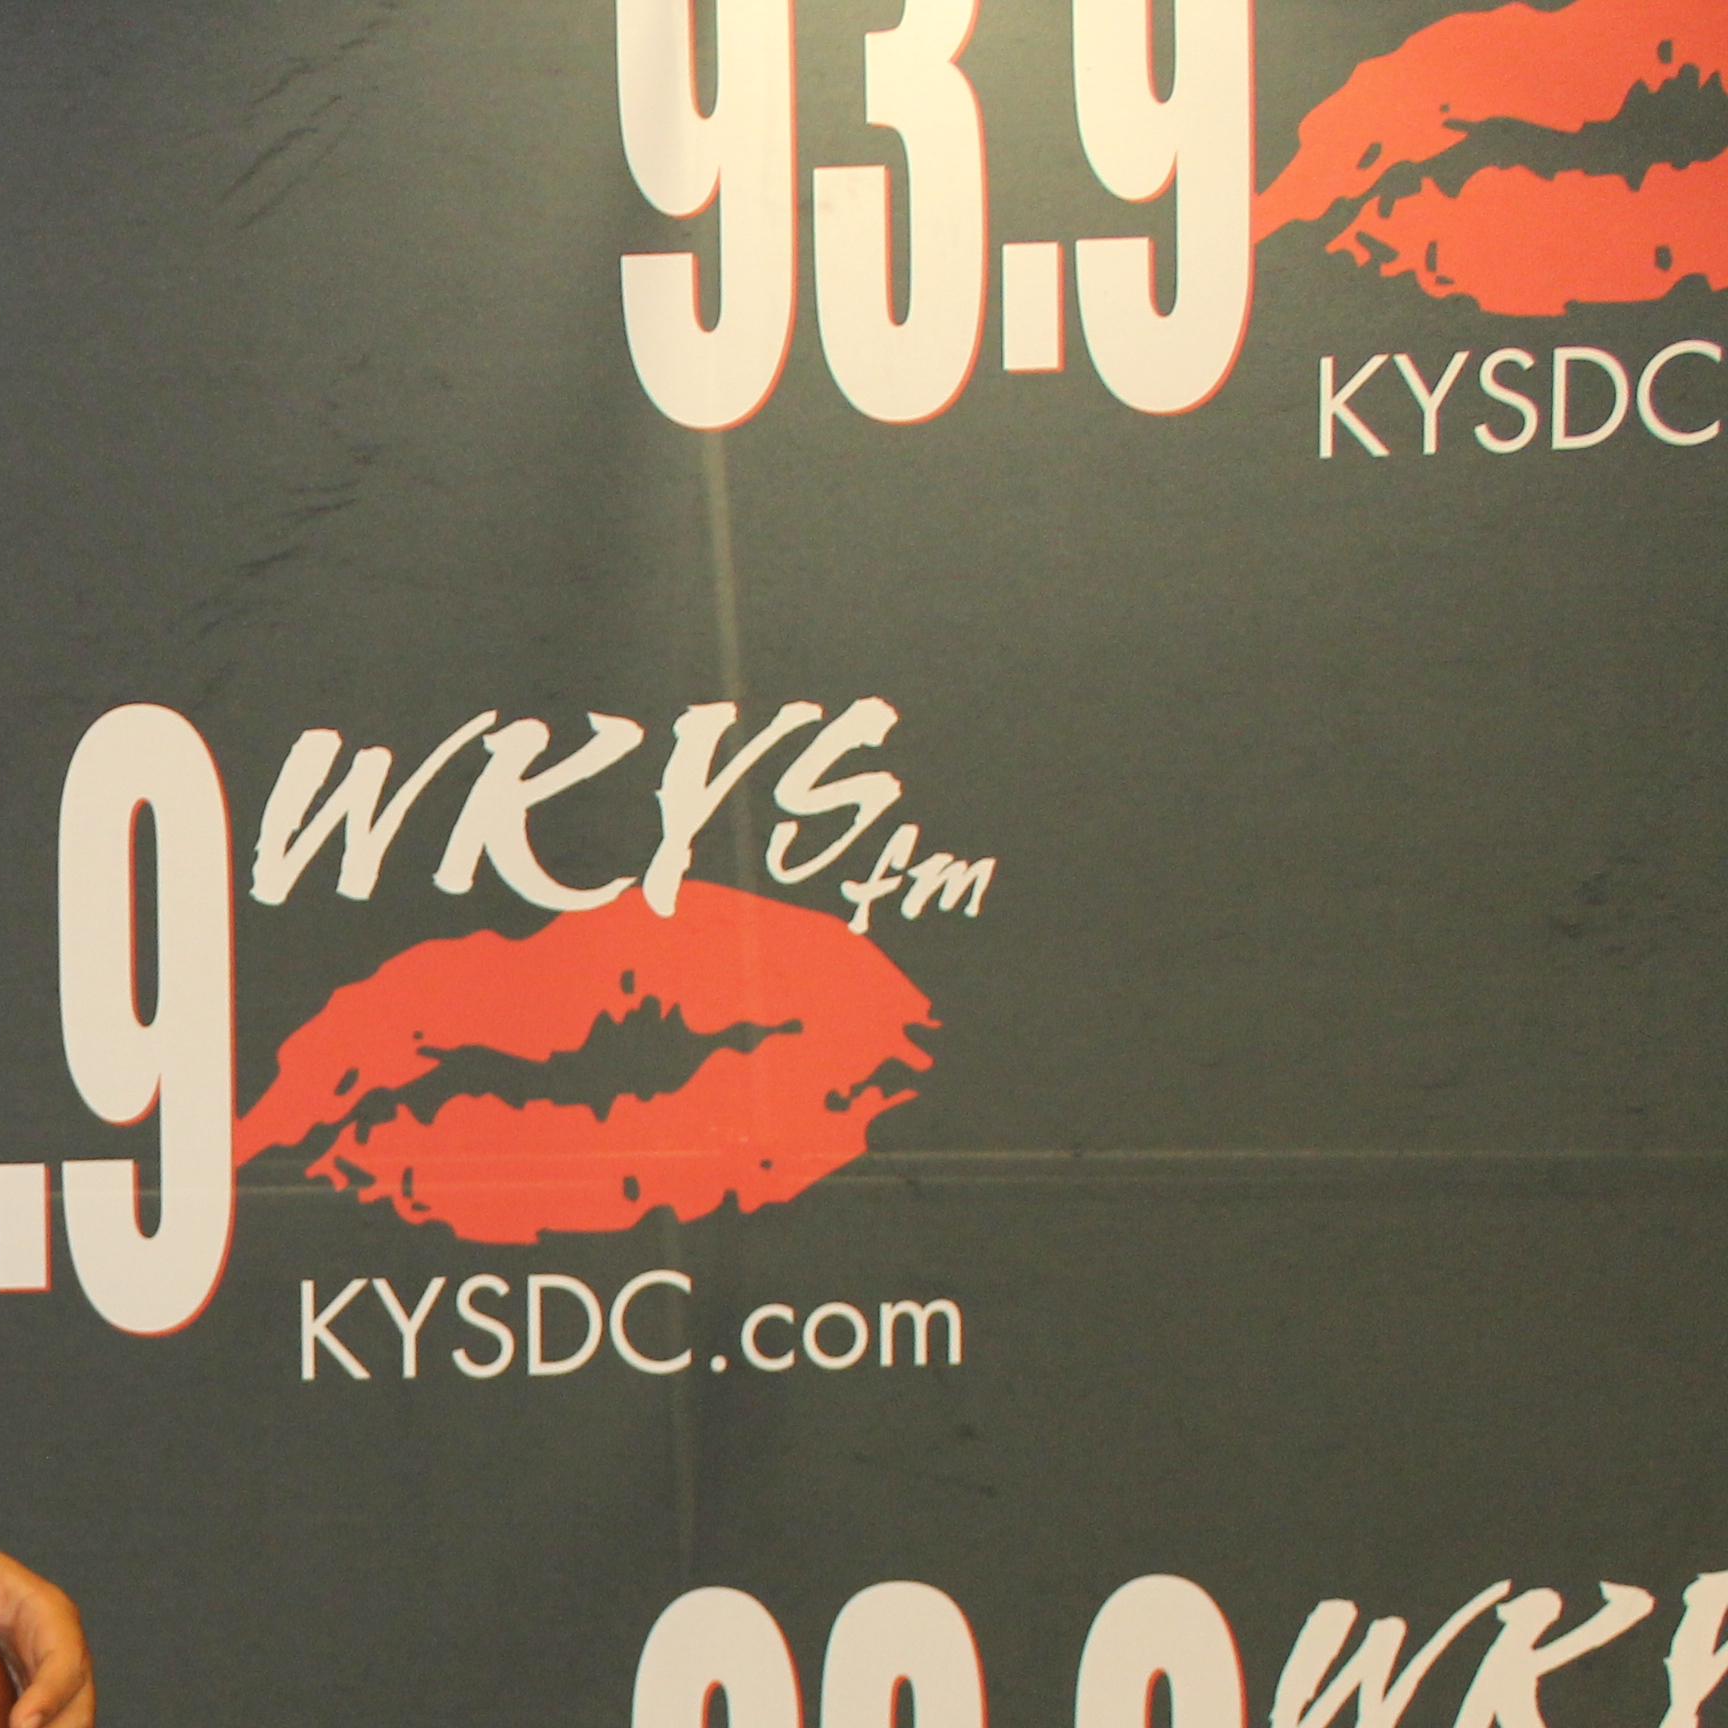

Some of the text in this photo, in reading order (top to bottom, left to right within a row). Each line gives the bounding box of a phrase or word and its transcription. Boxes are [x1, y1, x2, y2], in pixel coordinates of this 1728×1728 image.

[1318, 339, 1723, 460] KYSDC
[248, 696, 902, 918] WKYS
[839, 823, 996, 936] fm
[300, 1269, 962, 1382] KYSDC.com
